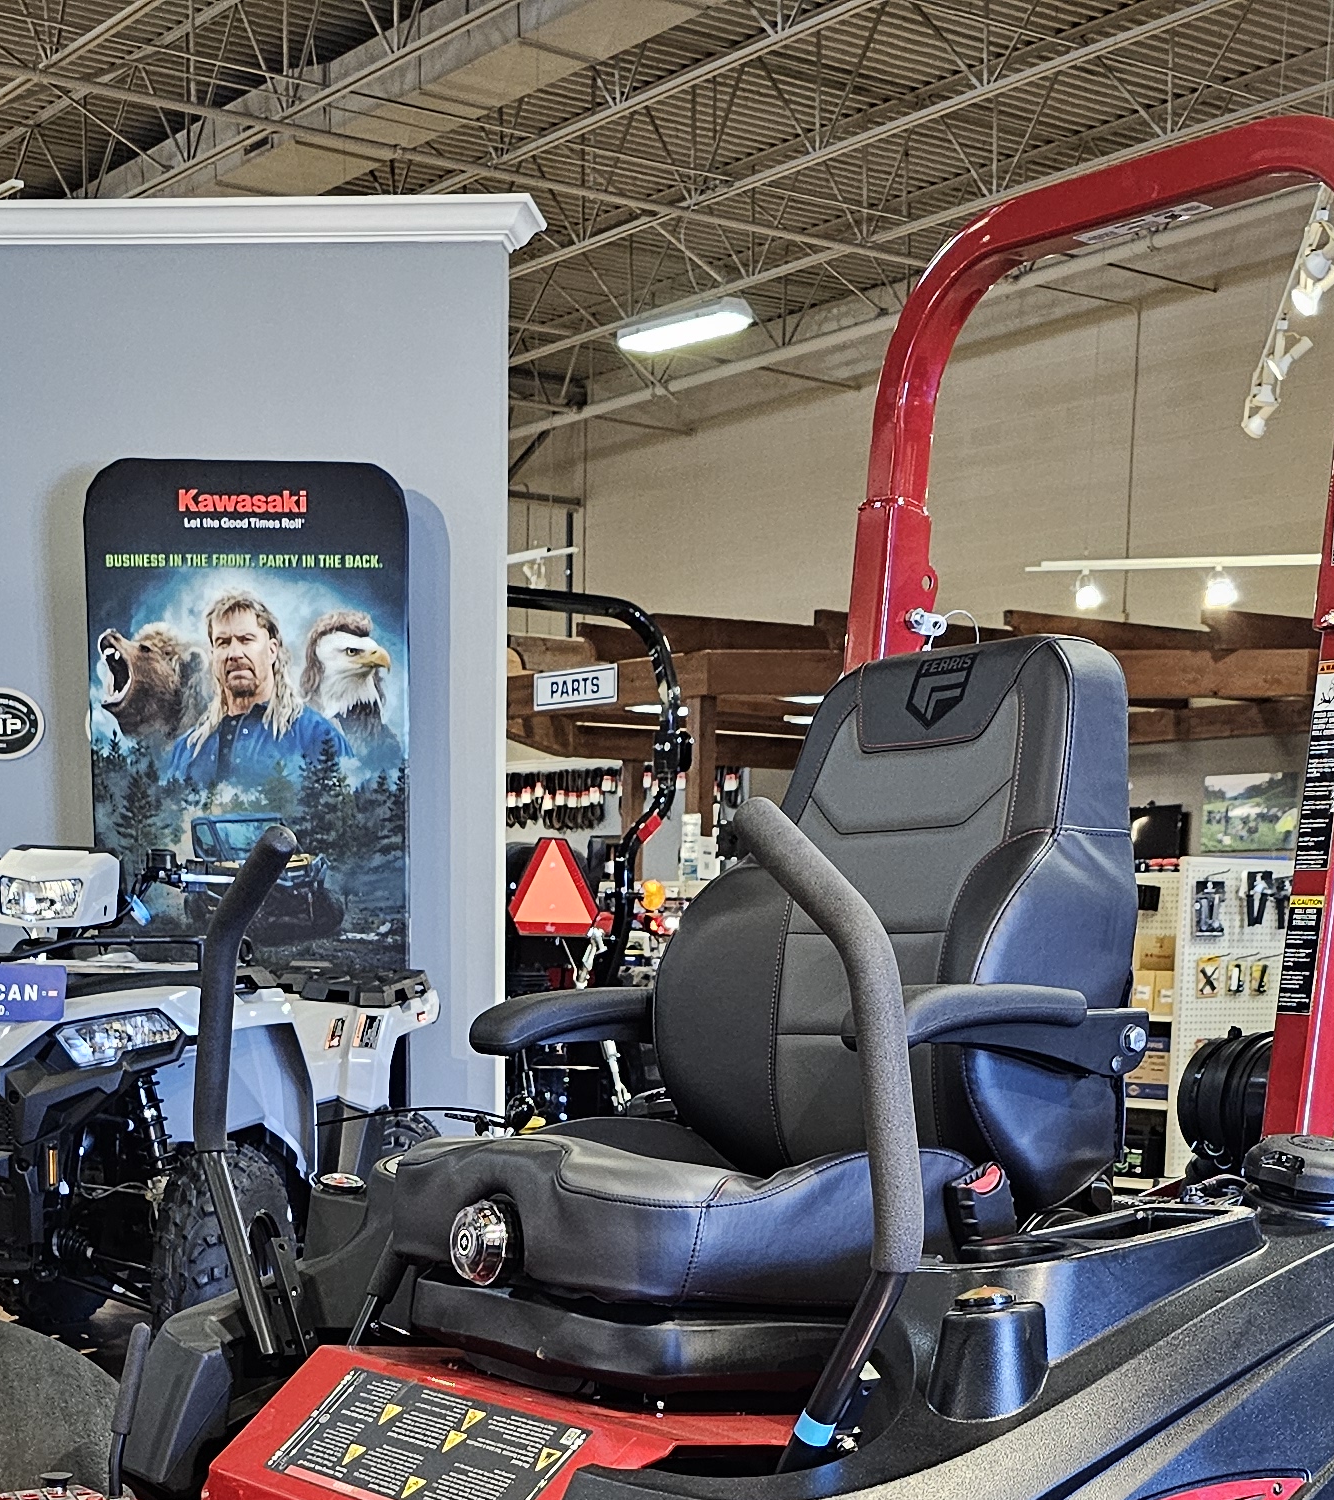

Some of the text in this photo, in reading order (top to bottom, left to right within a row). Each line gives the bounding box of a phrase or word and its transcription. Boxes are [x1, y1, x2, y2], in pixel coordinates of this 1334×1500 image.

[178, 489, 307, 513] Kawasaki
[184, 517, 201, 528] Let
[203, 517, 219, 528] the
[221, 517, 248, 529] Good
[250, 518, 280, 529] Times
[106, 554, 383, 569] BUSINESS IN THE FRONT. PARTY IN THE BACK.
[921, 654, 974, 674] FERRIS
[550, 676, 600, 699] PARTS
